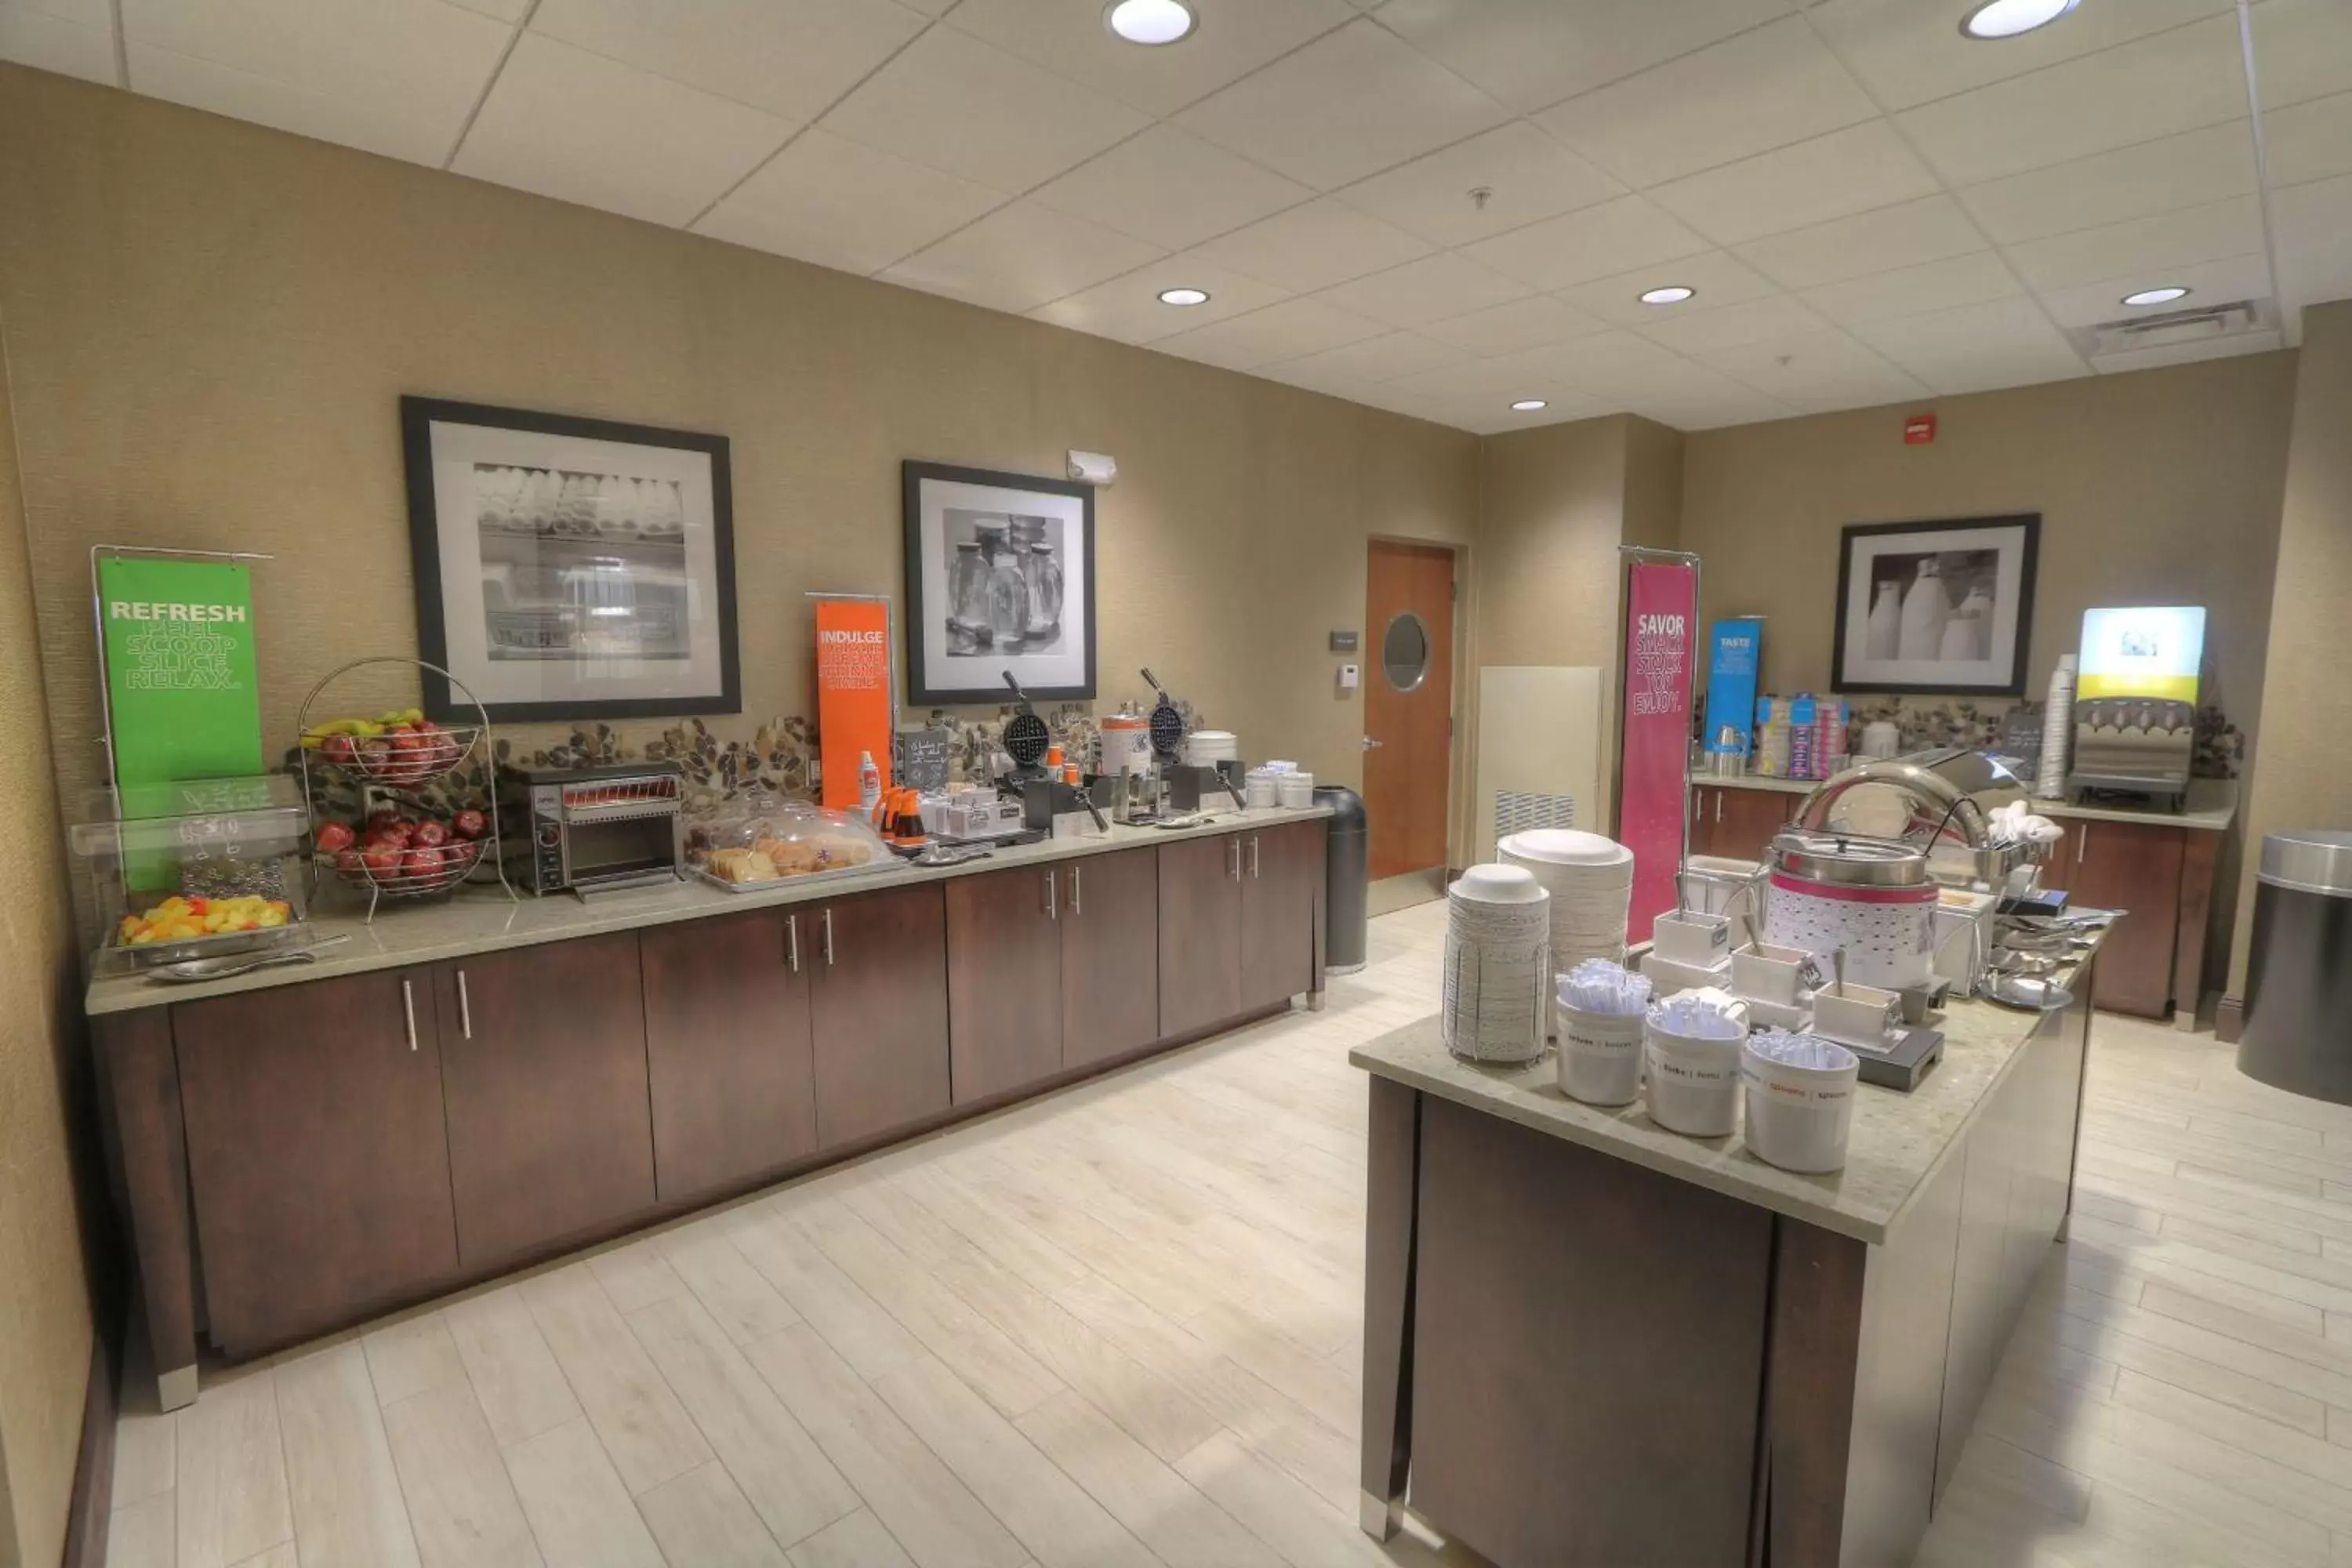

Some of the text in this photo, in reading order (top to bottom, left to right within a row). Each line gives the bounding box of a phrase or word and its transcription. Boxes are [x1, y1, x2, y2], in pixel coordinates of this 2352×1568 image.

[111, 601, 245, 622] REFRESH
[1639, 614, 1685, 636] SAVOR
[125, 634, 238, 655] SCOOP
[820, 630, 884, 644] INDULGE
[1720, 637, 1751, 648] TASTE
[139, 652, 227, 673] SLICE
